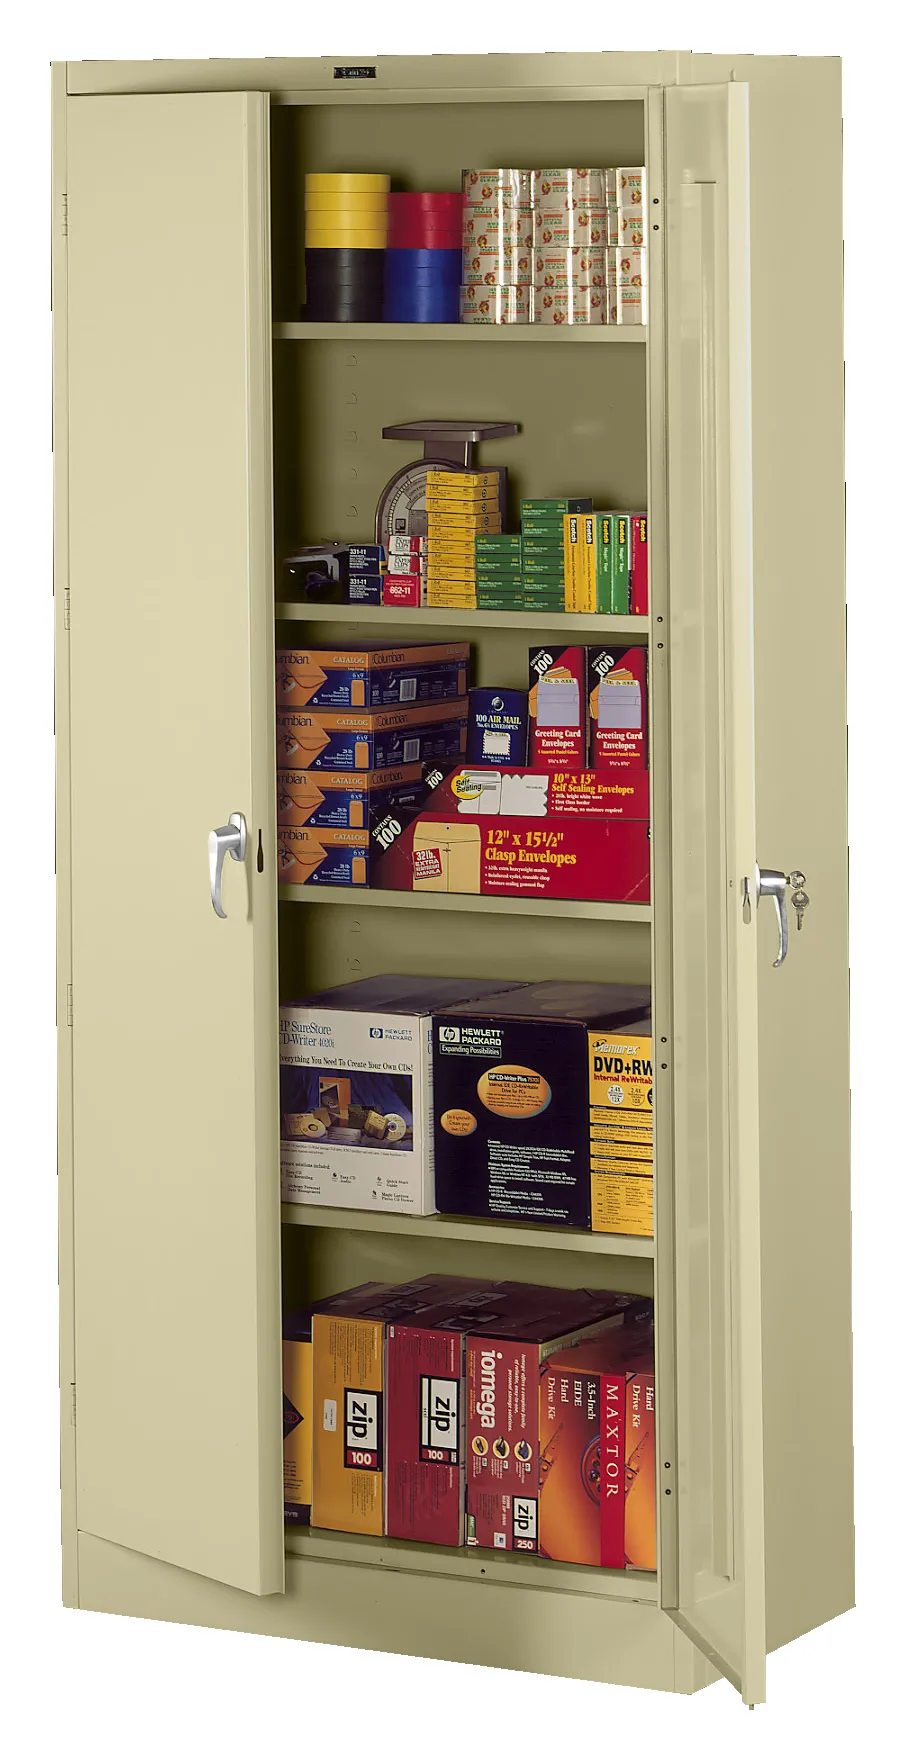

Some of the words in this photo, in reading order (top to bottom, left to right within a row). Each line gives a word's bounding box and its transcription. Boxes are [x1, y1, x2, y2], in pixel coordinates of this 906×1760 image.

[374, 652, 404, 664] Columbian
[533, 654, 554, 676] 100
[594, 655, 615, 677] 100
[376, 713, 408, 727] Columbian
[476, 714, 487, 722] 100
[488, 715, 502, 724] AIR
[503, 716, 522, 724] MAIL
[534, 730, 564, 739] Greeting
[564, 730, 581, 738] Card
[596, 732, 626, 742] Greeting
[626, 732, 643, 740] Card
[542, 739, 574, 748] Envelopes
[602, 742, 636, 751] Envelopes
[372, 771, 403, 784] Columbian
[428, 771, 444, 790] 100
[456, 779, 470, 787] Self
[554, 773, 570, 784] 10"
[580, 774, 596, 784] 13"
[456, 784, 482, 793] Sealing
[552, 784, 567, 792] Self
[568, 784, 596, 795] Sealing
[598, 785, 635, 796] Envelopes
[372, 814, 393, 837] CONTAINS
[376, 819, 402, 850] 100
[486, 830, 510, 845] 12"
[512, 834, 522, 846] x
[415, 858, 440, 867] EXTRA
[416, 850, 436, 861] 32lb.
[485, 848, 516, 865] Clasp
[518, 849, 577, 868] Envelopes
[292, 1020, 332, 1035] SureStore
[462, 1028, 501, 1037] HEWLETT
[318, 1038, 335, 1048] 4020i
[462, 1036, 502, 1046] PACKARD
[592, 1039, 639, 1055] Memorex
[442, 1044, 470, 1054] Expanding
[470, 1046, 500, 1056] Possibilities
[280, 1054, 310, 1065] verything
[312, 1056, 322, 1064] You
[323, 1057, 338, 1065] Need
[347, 1060, 367, 1068] Create
[368, 1062, 382, 1070] Your
[382, 1062, 396, 1070] Own
[594, 1073, 620, 1082] Internal
[476, 1350, 503, 1428] iomega
[548, 1377, 556, 1402] Drive
[560, 1379, 569, 1403] Hard
[574, 1380, 582, 1407] EIDE
[587, 1382, 596, 1420] 3.5-Inch
[632, 1384, 640, 1410] Drive
[645, 1386, 654, 1410] Hard
[348, 1400, 372, 1438] zip
[431, 1396, 456, 1432] zip
[548, 1406, 556, 1420] Kit
[632, 1414, 641, 1428] Kit
[606, 1384, 619, 1498] MAXTOR
[352, 1452, 372, 1465] 100
[427, 1450, 444, 1460] 100
[514, 1504, 533, 1530] zip
[518, 1540, 533, 1549] 250
